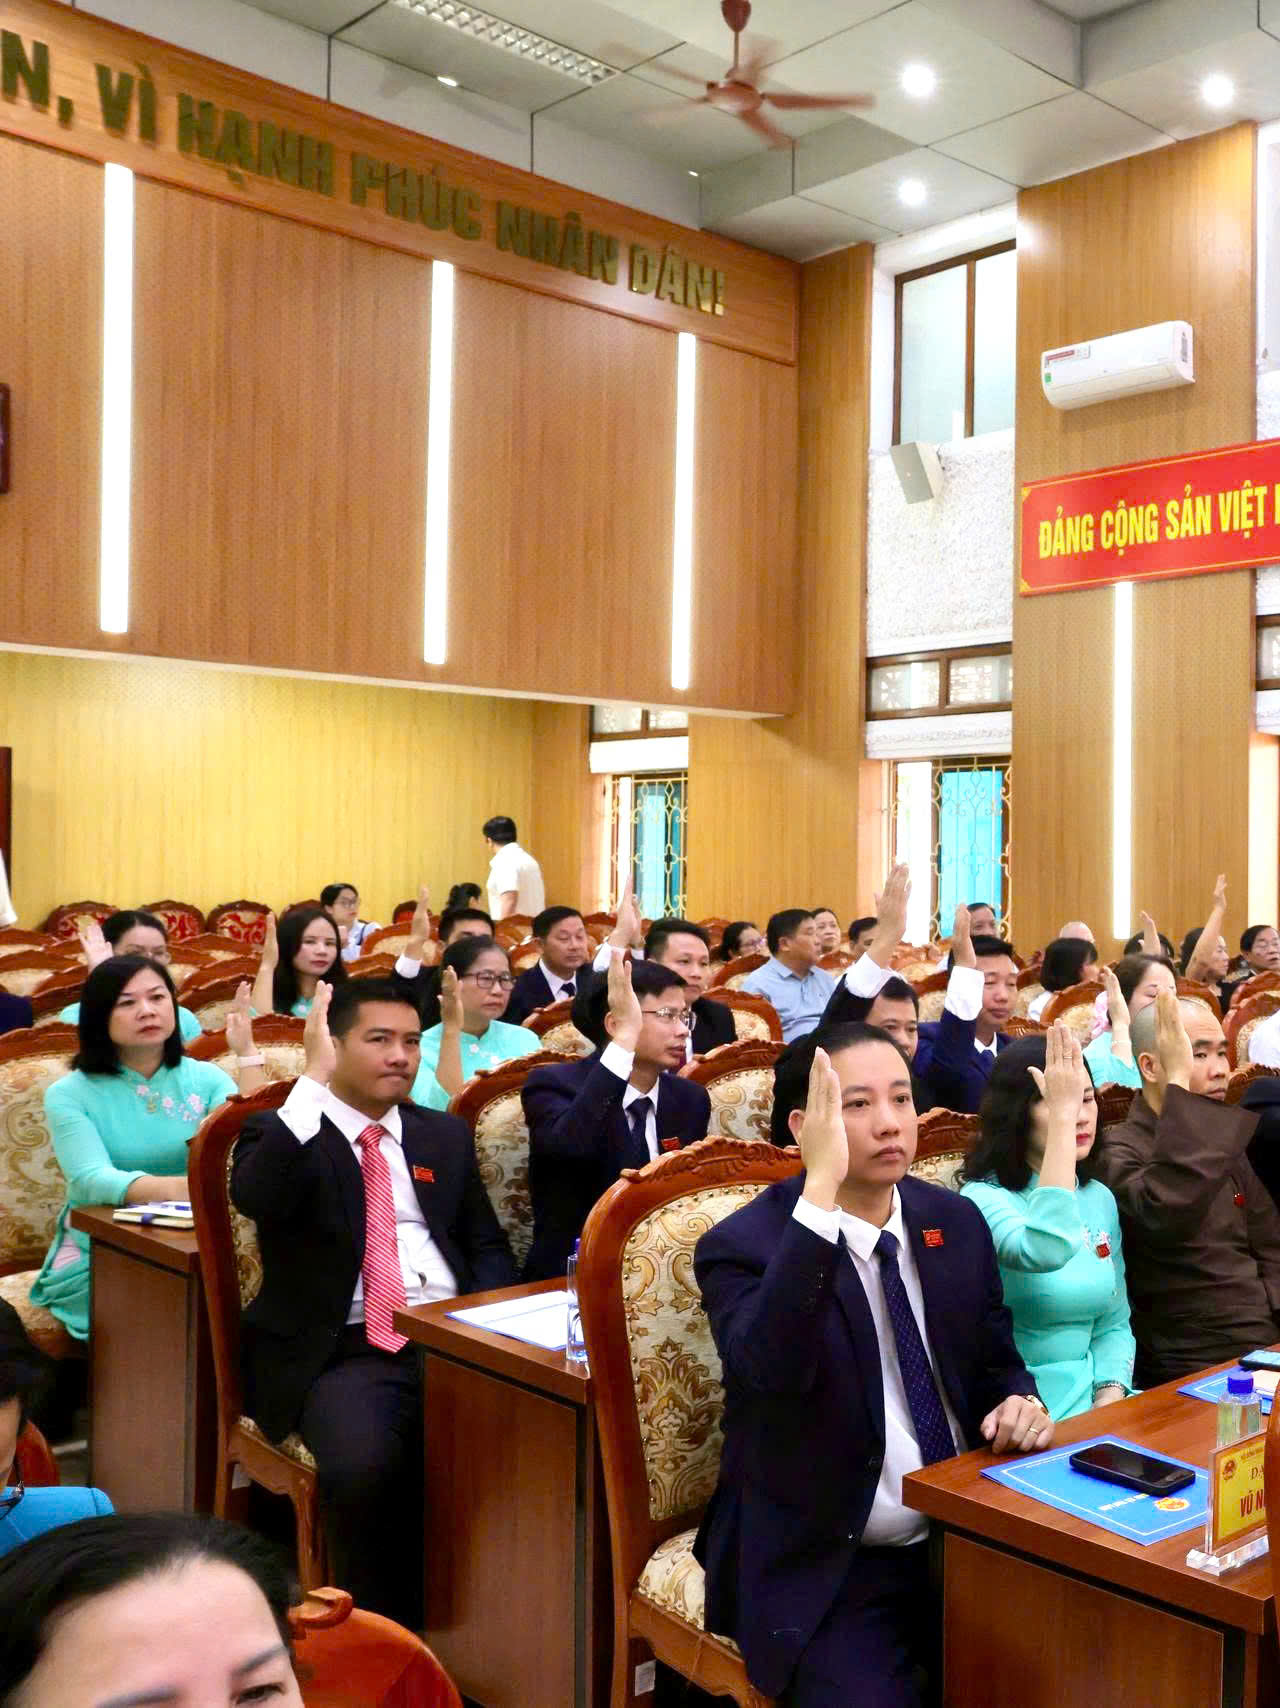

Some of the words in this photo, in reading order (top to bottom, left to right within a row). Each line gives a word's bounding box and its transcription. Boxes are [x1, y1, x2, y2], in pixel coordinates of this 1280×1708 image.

[95, 62, 158, 146] VÌ
[176, 92, 336, 198] HẠNH
[350, 149, 482, 240] PHÚC
[496, 199, 620, 286] NHÂN
[1040, 505, 1094, 559] ĐẢNG
[1101, 500, 1158, 556] CỘNG
[1165, 484, 1212, 540] SẢN
[1219, 479, 1268, 537] VIỆT
